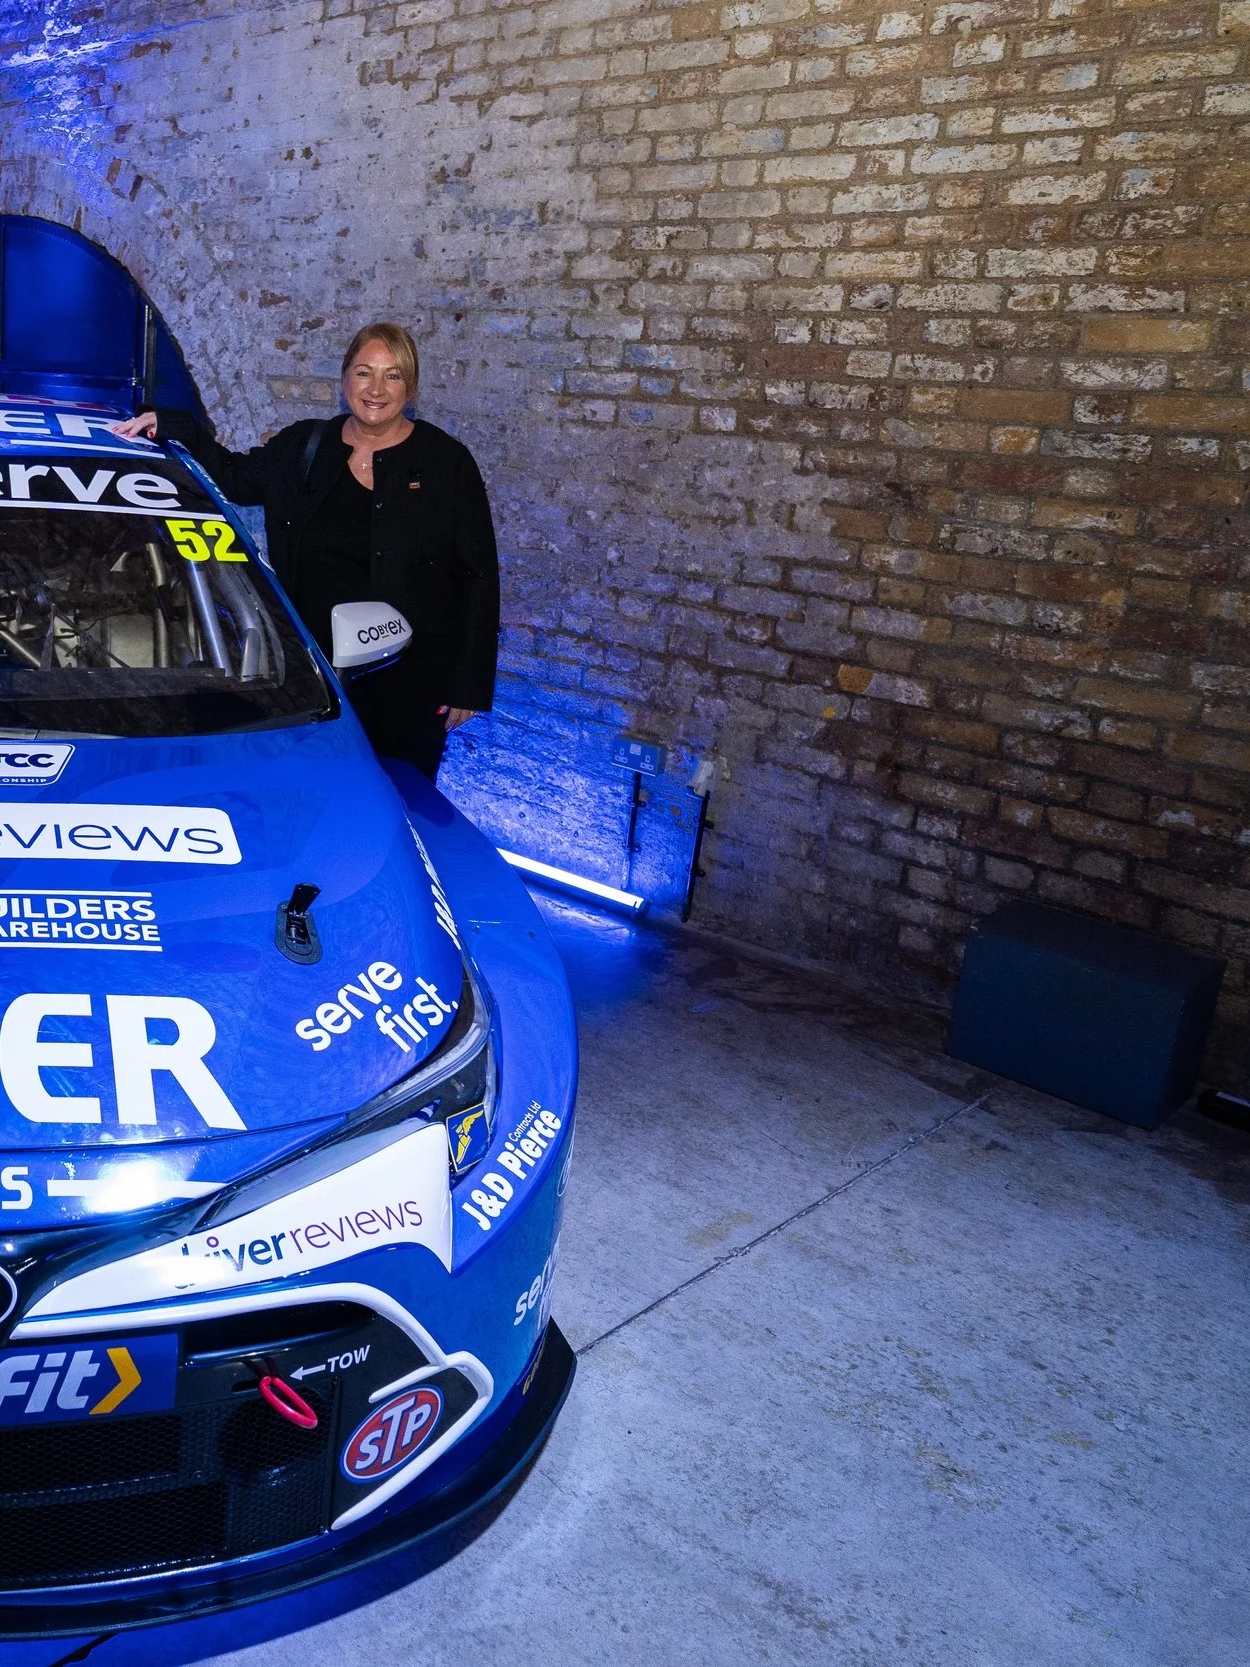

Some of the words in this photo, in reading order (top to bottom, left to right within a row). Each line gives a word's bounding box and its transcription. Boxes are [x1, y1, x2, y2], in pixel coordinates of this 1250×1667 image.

[165, 519, 249, 562] 52
[295, 961, 403, 1052] serve
[375, 976, 459, 1053] first.
[508, 1111, 535, 1142] Contracts
[527, 1099, 542, 1114] Ltd
[462, 1172, 514, 1231] J&D
[496, 1110, 562, 1180] Pierce
[327, 1344, 371, 1373] TOW
[354, 1394, 433, 1471] STP
